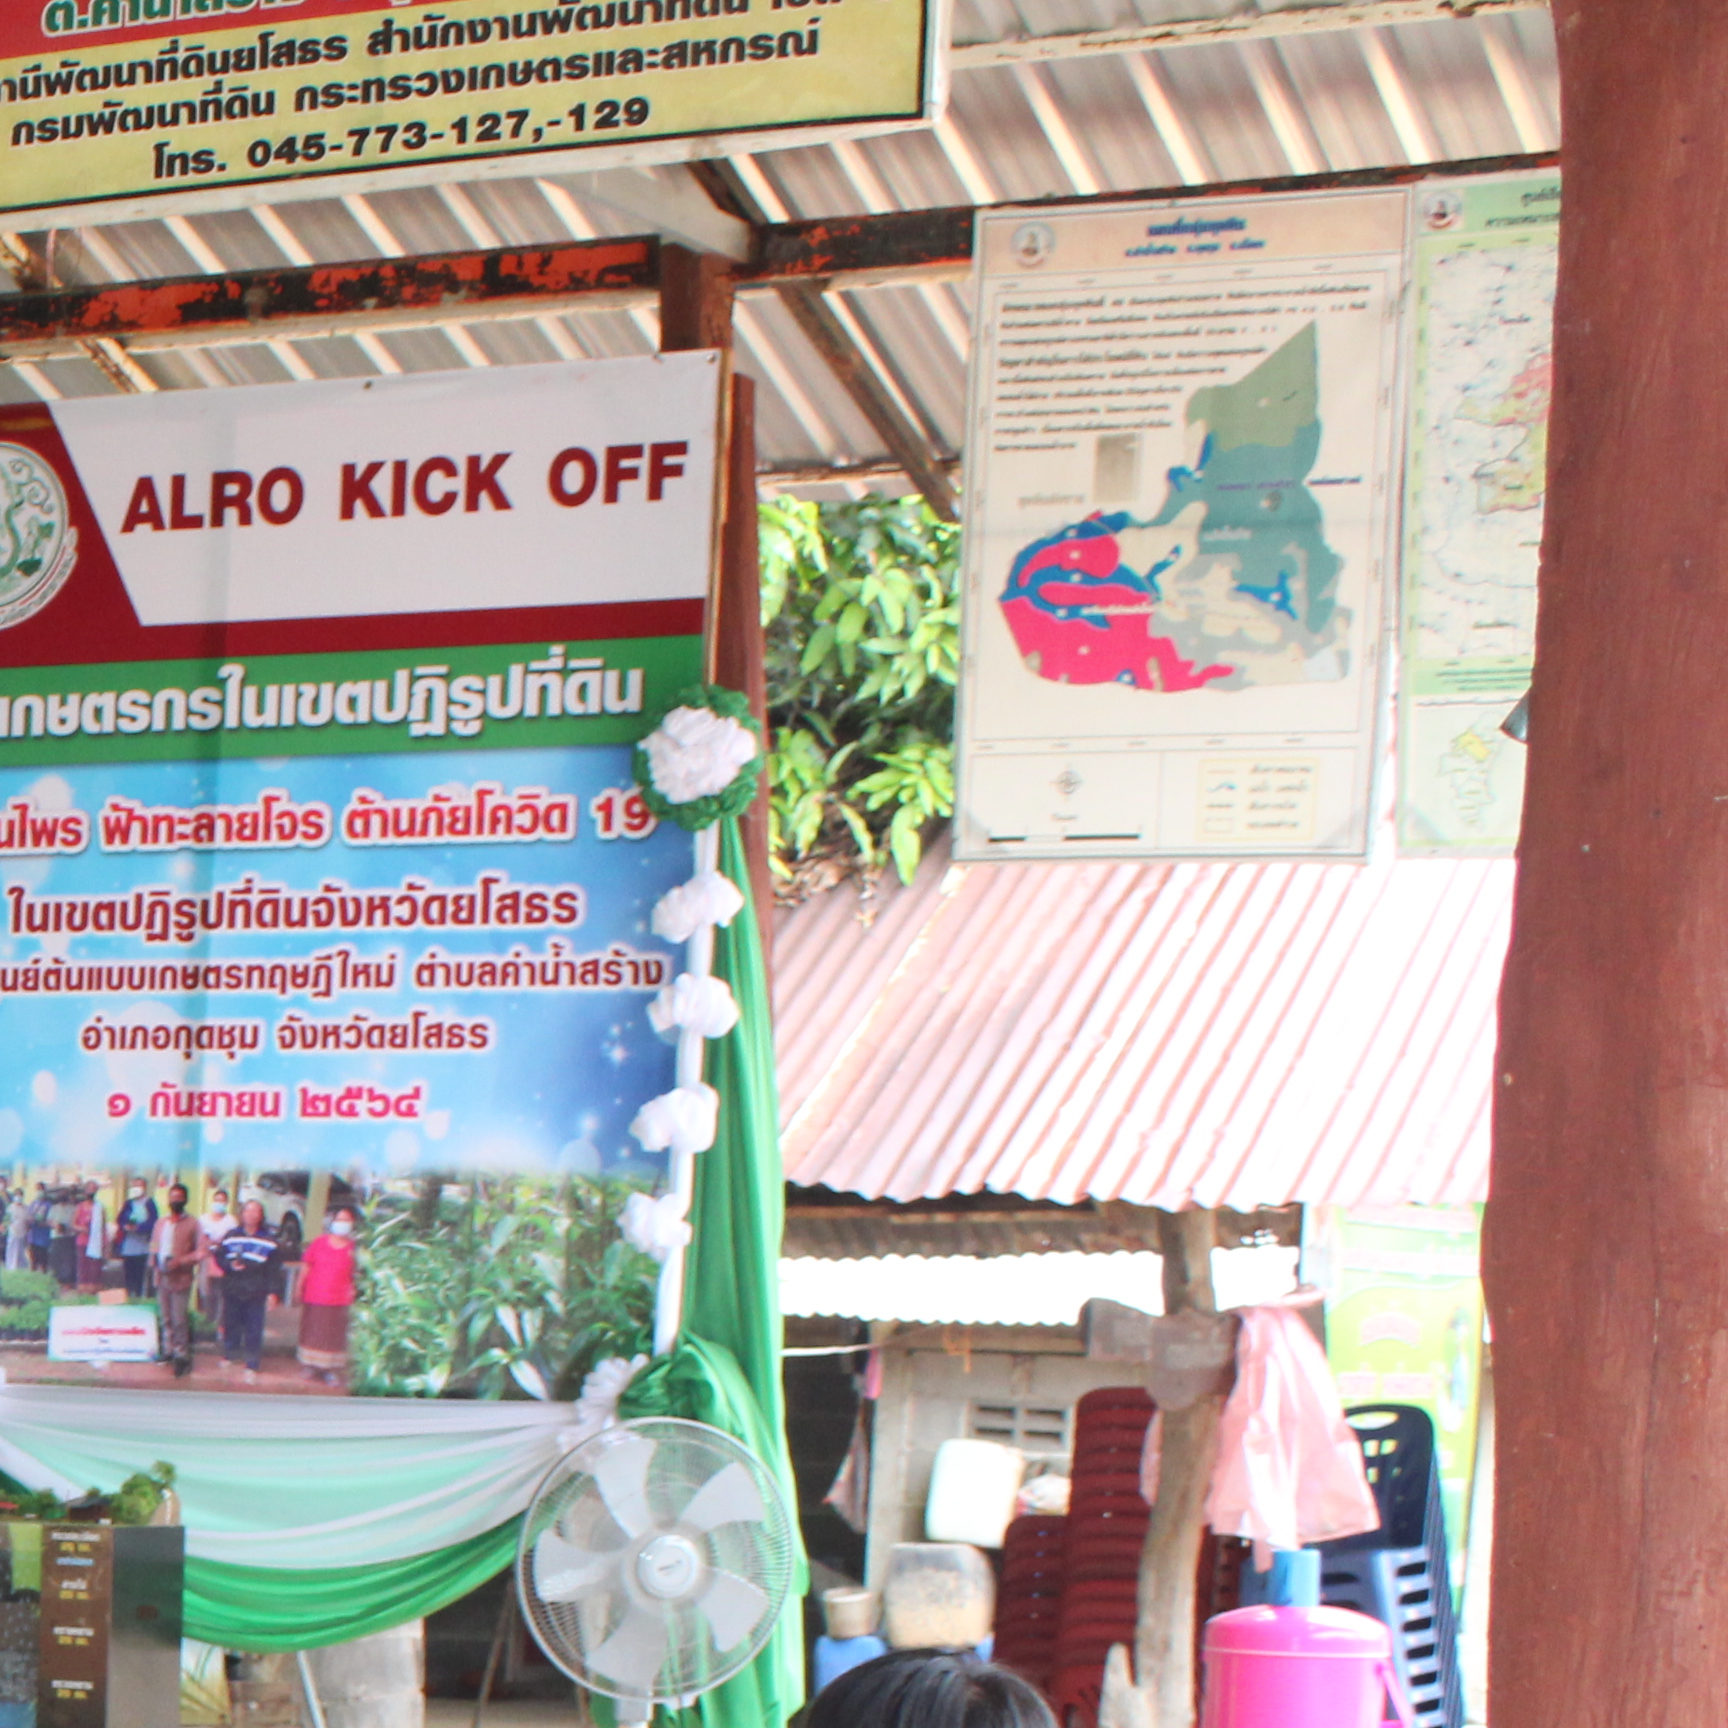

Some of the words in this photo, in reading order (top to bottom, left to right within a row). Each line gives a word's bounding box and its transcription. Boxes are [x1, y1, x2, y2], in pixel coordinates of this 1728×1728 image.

[11, 80, 276, 147] กรมพัฒนาที่ดิน
[293, 16, 822, 110] กระทรวงเกษตรและสหกรณ์
[152, 141, 228, 180] โทร.
[247, 96, 651, 168] 045-773-127,-129
[120, 467, 305, 534] ALRO
[338, 451, 515, 521] KICK
[546, 440, 690, 509] OFF
[103, 789, 328, 851] ฟ้าทะลายโจร
[344, 782, 572, 842] ต้านภัยโควิด
[594, 793, 651, 838] 19
[8, 879, 581, 941] ในเขตปฏิรูปที่ดินจังหวัดยโสธร
[414, 942, 665, 990] ตำบลคำน้ำสร้าง
[80, 1020, 260, 1060] อำเภอกุดชุม
[276, 1010, 490, 1052] จังหวัดยโสธร
[106, 1090, 132, 1119] ๑
[148, 1081, 282, 1119] กันยายน
[298, 1084, 423, 1120] ๒๕๖๔
